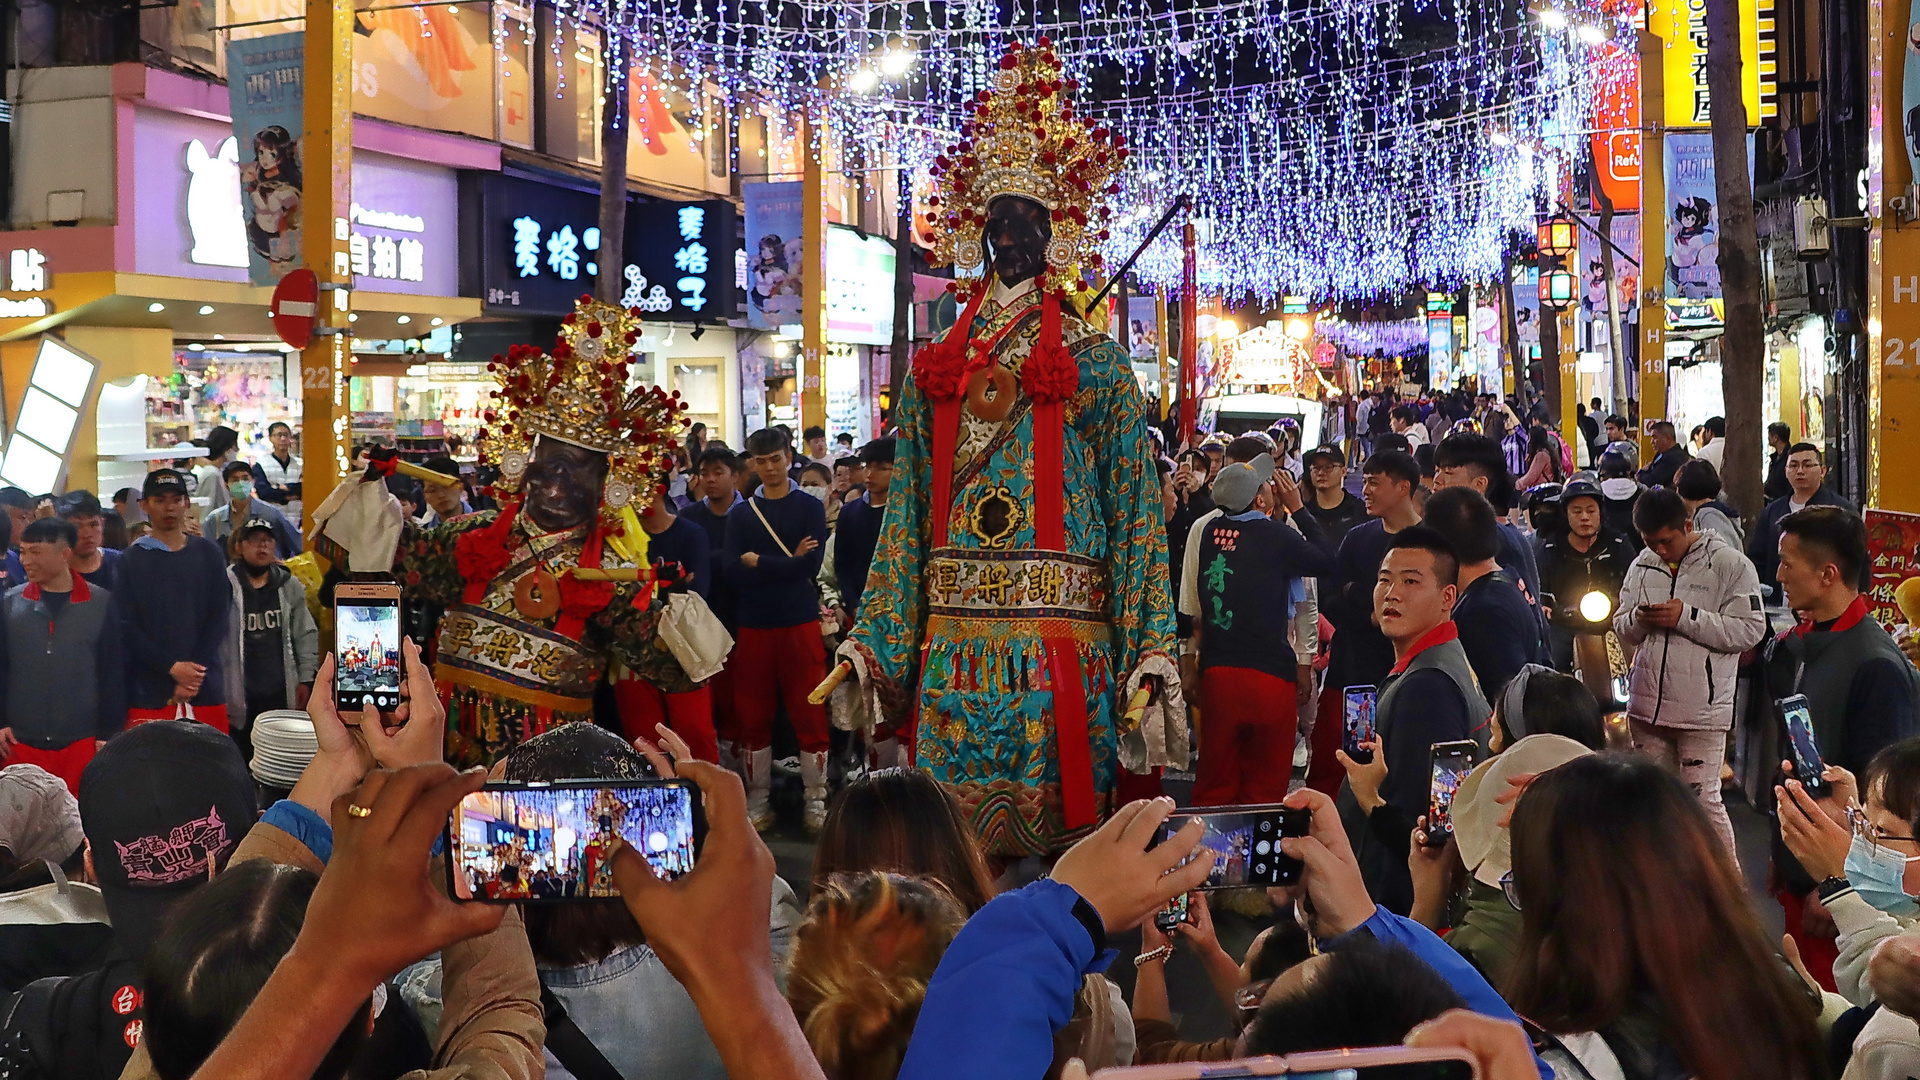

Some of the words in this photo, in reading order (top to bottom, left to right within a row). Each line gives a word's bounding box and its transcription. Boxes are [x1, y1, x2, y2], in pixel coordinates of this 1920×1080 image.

[674, 206, 709, 311] 麥格子
[1893, 276, 1918, 303] H
[1647, 329, 1660, 344] H
[806, 348, 818, 361] H
[1562, 362, 1576, 374] 17
[1644, 358, 1664, 374] 19
[303, 366, 330, 389] 22
[804, 374, 820, 388] 20
[1873, 552, 1905, 571] 金門
[934, 559, 1065, 606] 謝將軍
[1203, 552, 1235, 631] 青山
